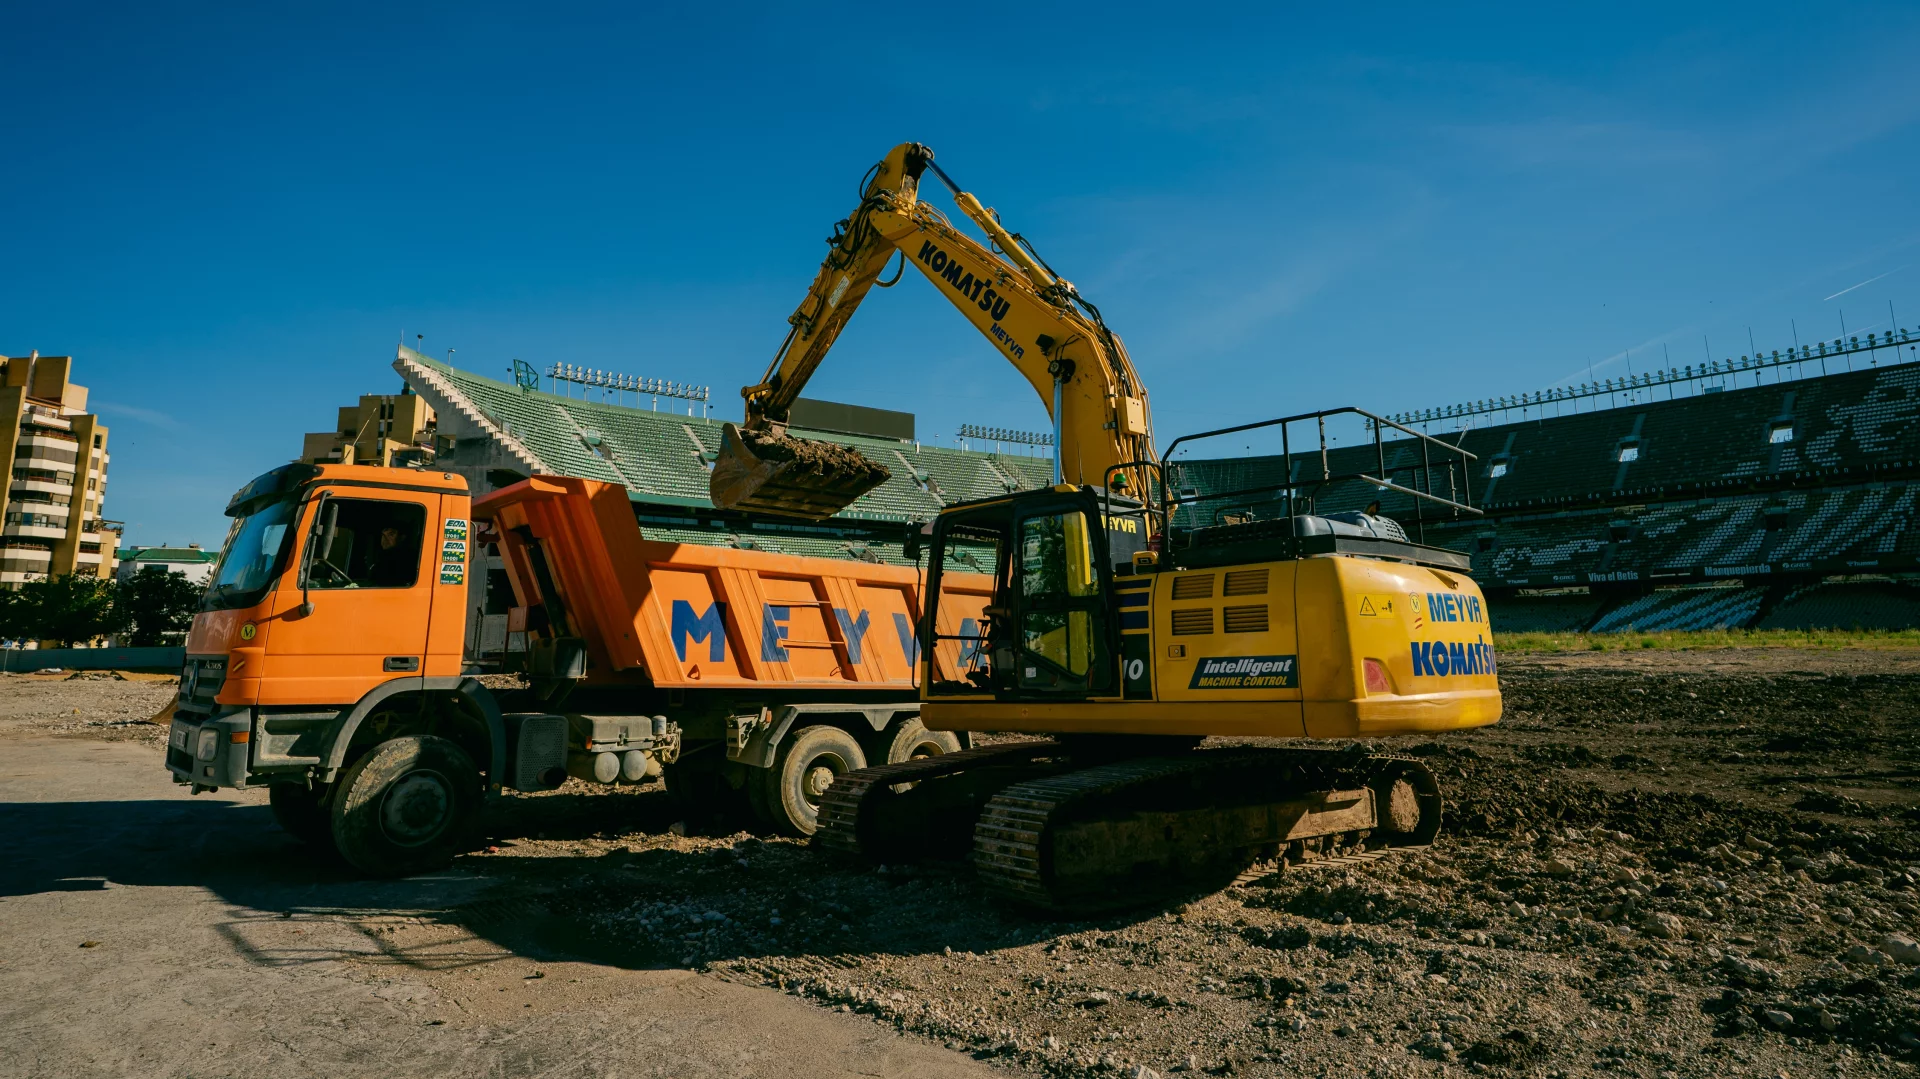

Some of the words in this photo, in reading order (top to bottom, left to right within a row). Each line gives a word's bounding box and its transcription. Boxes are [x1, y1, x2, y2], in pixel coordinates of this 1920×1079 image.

[918, 239, 1011, 321] KOMATSU
[990, 322, 1025, 360] MEYVA
[1755, 474, 1780, 482] una
[1865, 459, 1920, 471] llama
[1588, 572, 1606, 582] Viva
[1607, 572, 1615, 581] el
[1616, 571, 1639, 581] Betis
[1426, 592, 1483, 623] MEYVA
[671, 599, 987, 668] MEYVA
[1203, 658, 1292, 677] intelligent
[1410, 634, 1497, 677] KOMATSU
[1197, 677, 1243, 687] MACHINE
[1243, 675, 1288, 687] CONTROL
